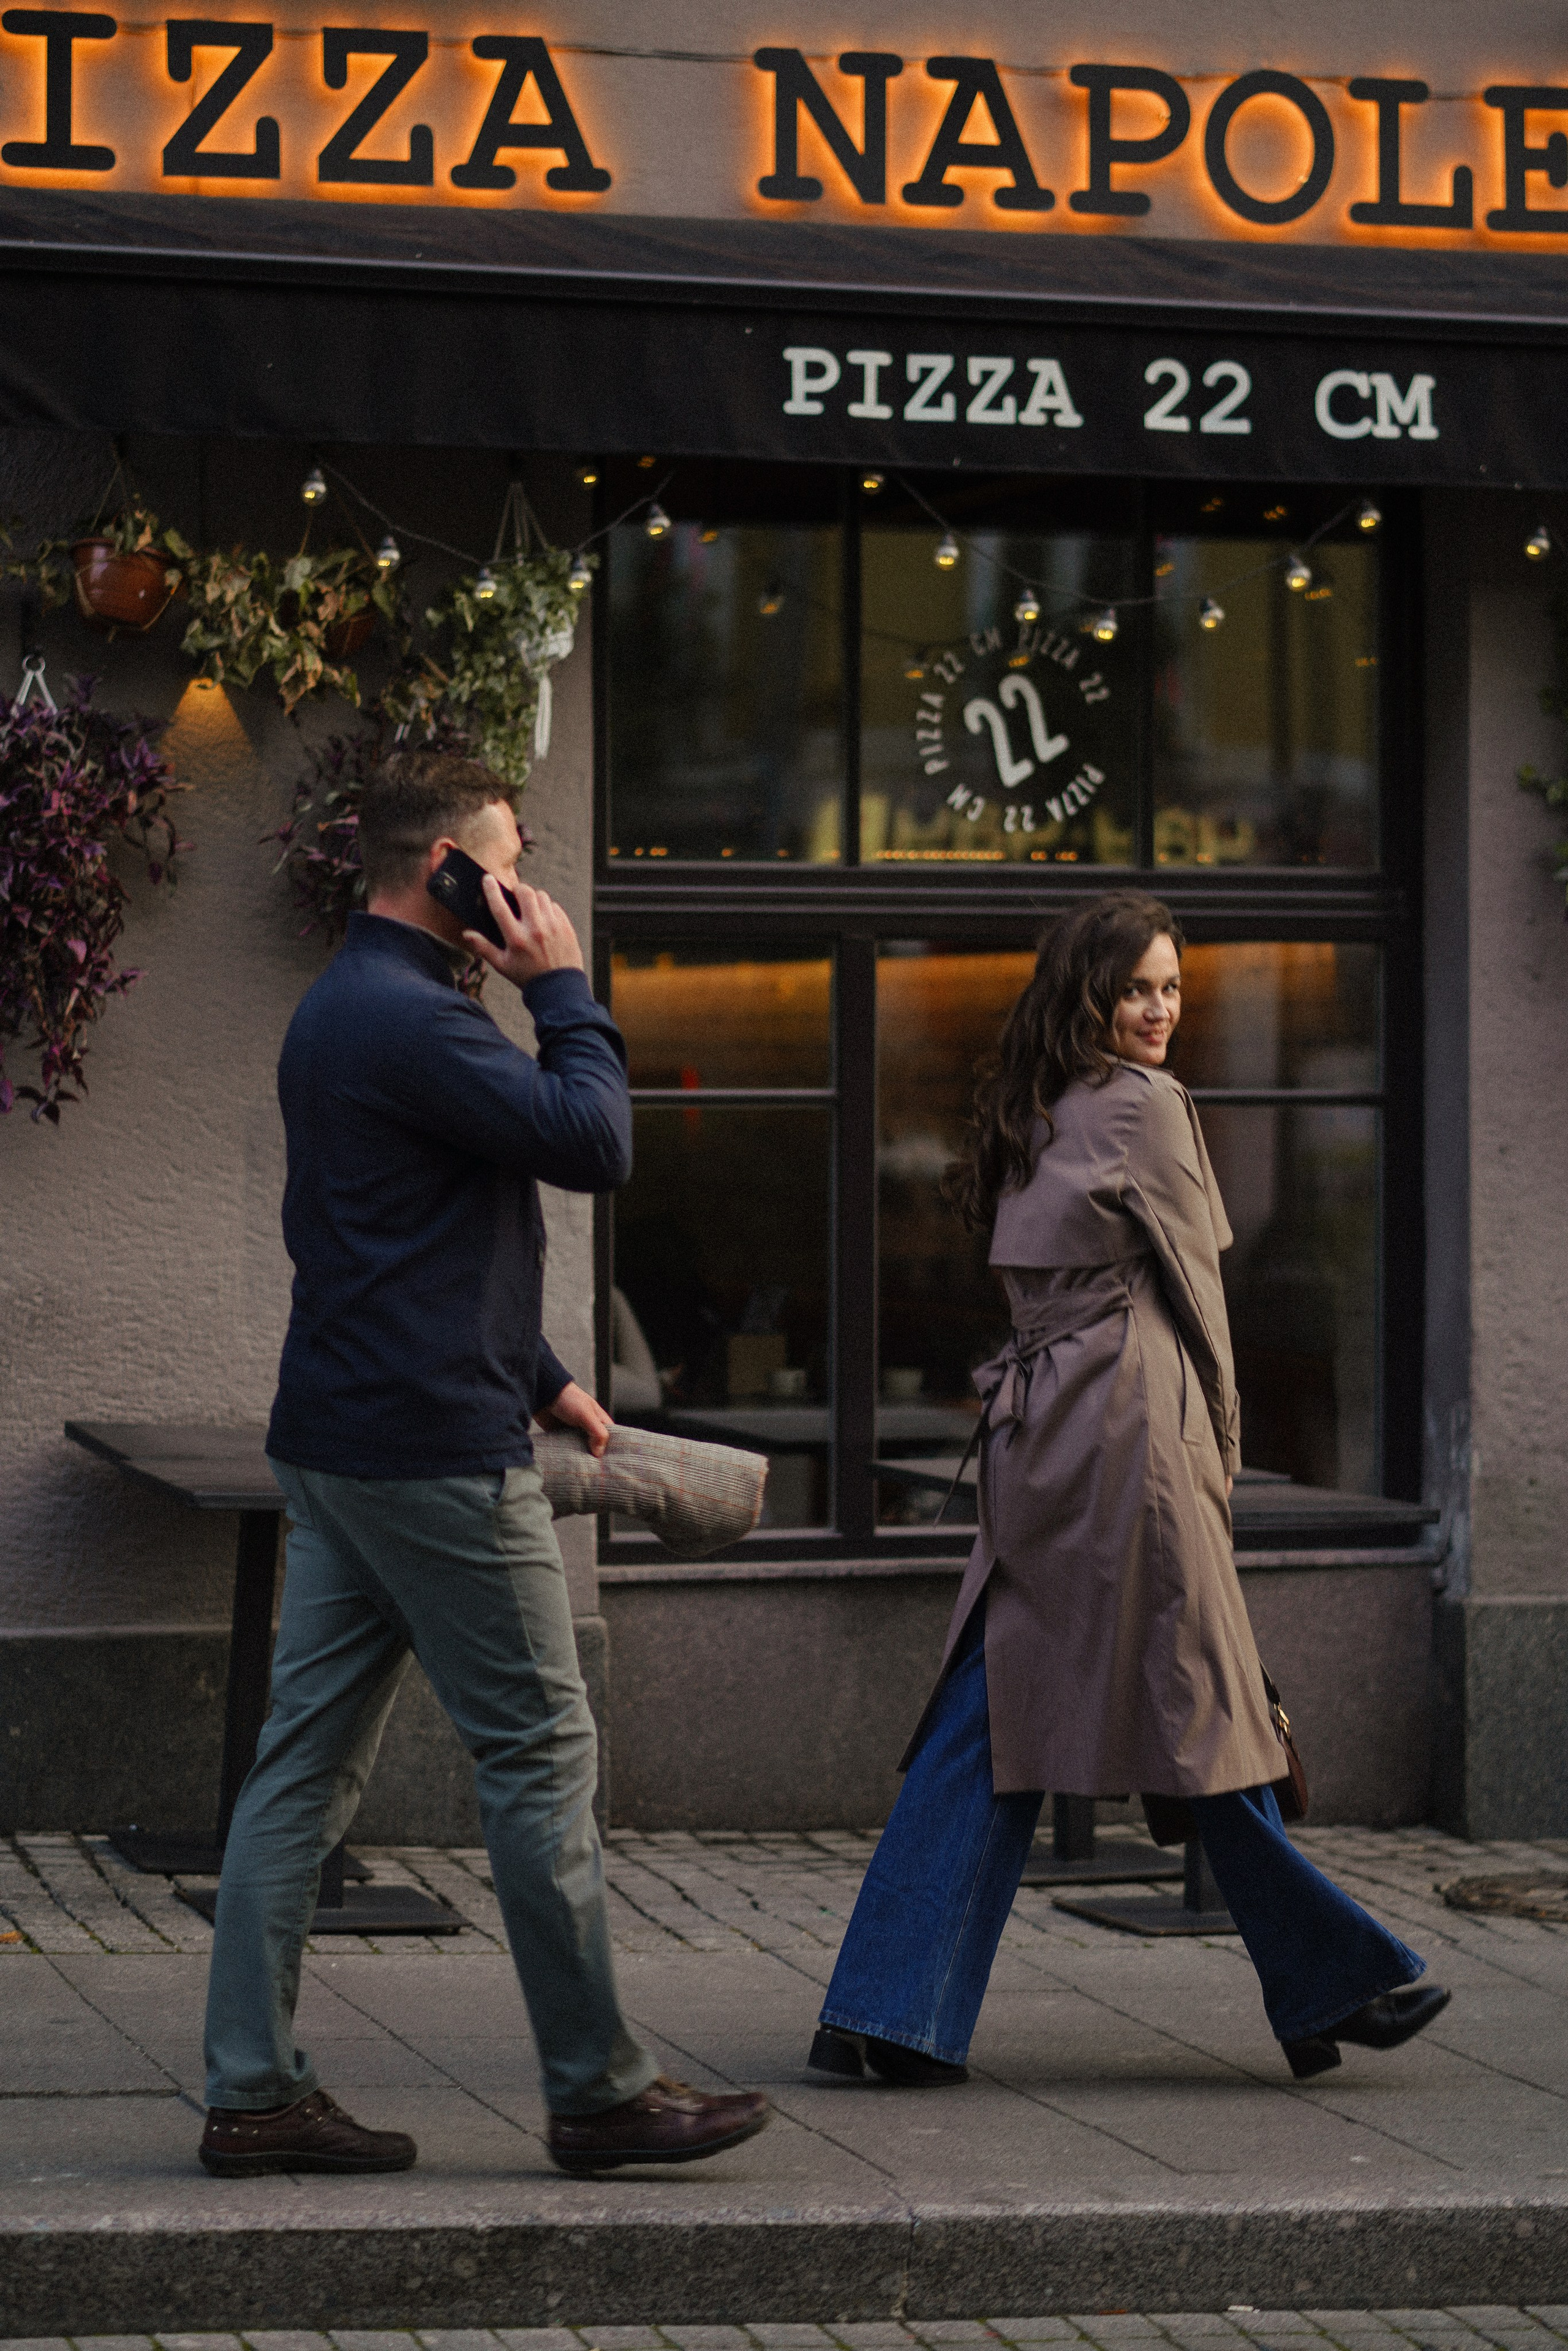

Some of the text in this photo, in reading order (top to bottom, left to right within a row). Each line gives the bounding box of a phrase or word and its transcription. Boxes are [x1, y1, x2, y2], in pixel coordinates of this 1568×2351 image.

[1, 9, 1568, 233] IZZA NAPOLE
[783, 347, 1439, 440] PIZZA 22 CM
[916, 626, 1110, 832] PIZZA 22 CM PIZZA 22 PIZZA 22 CM
[964, 674, 1069, 787] 22
